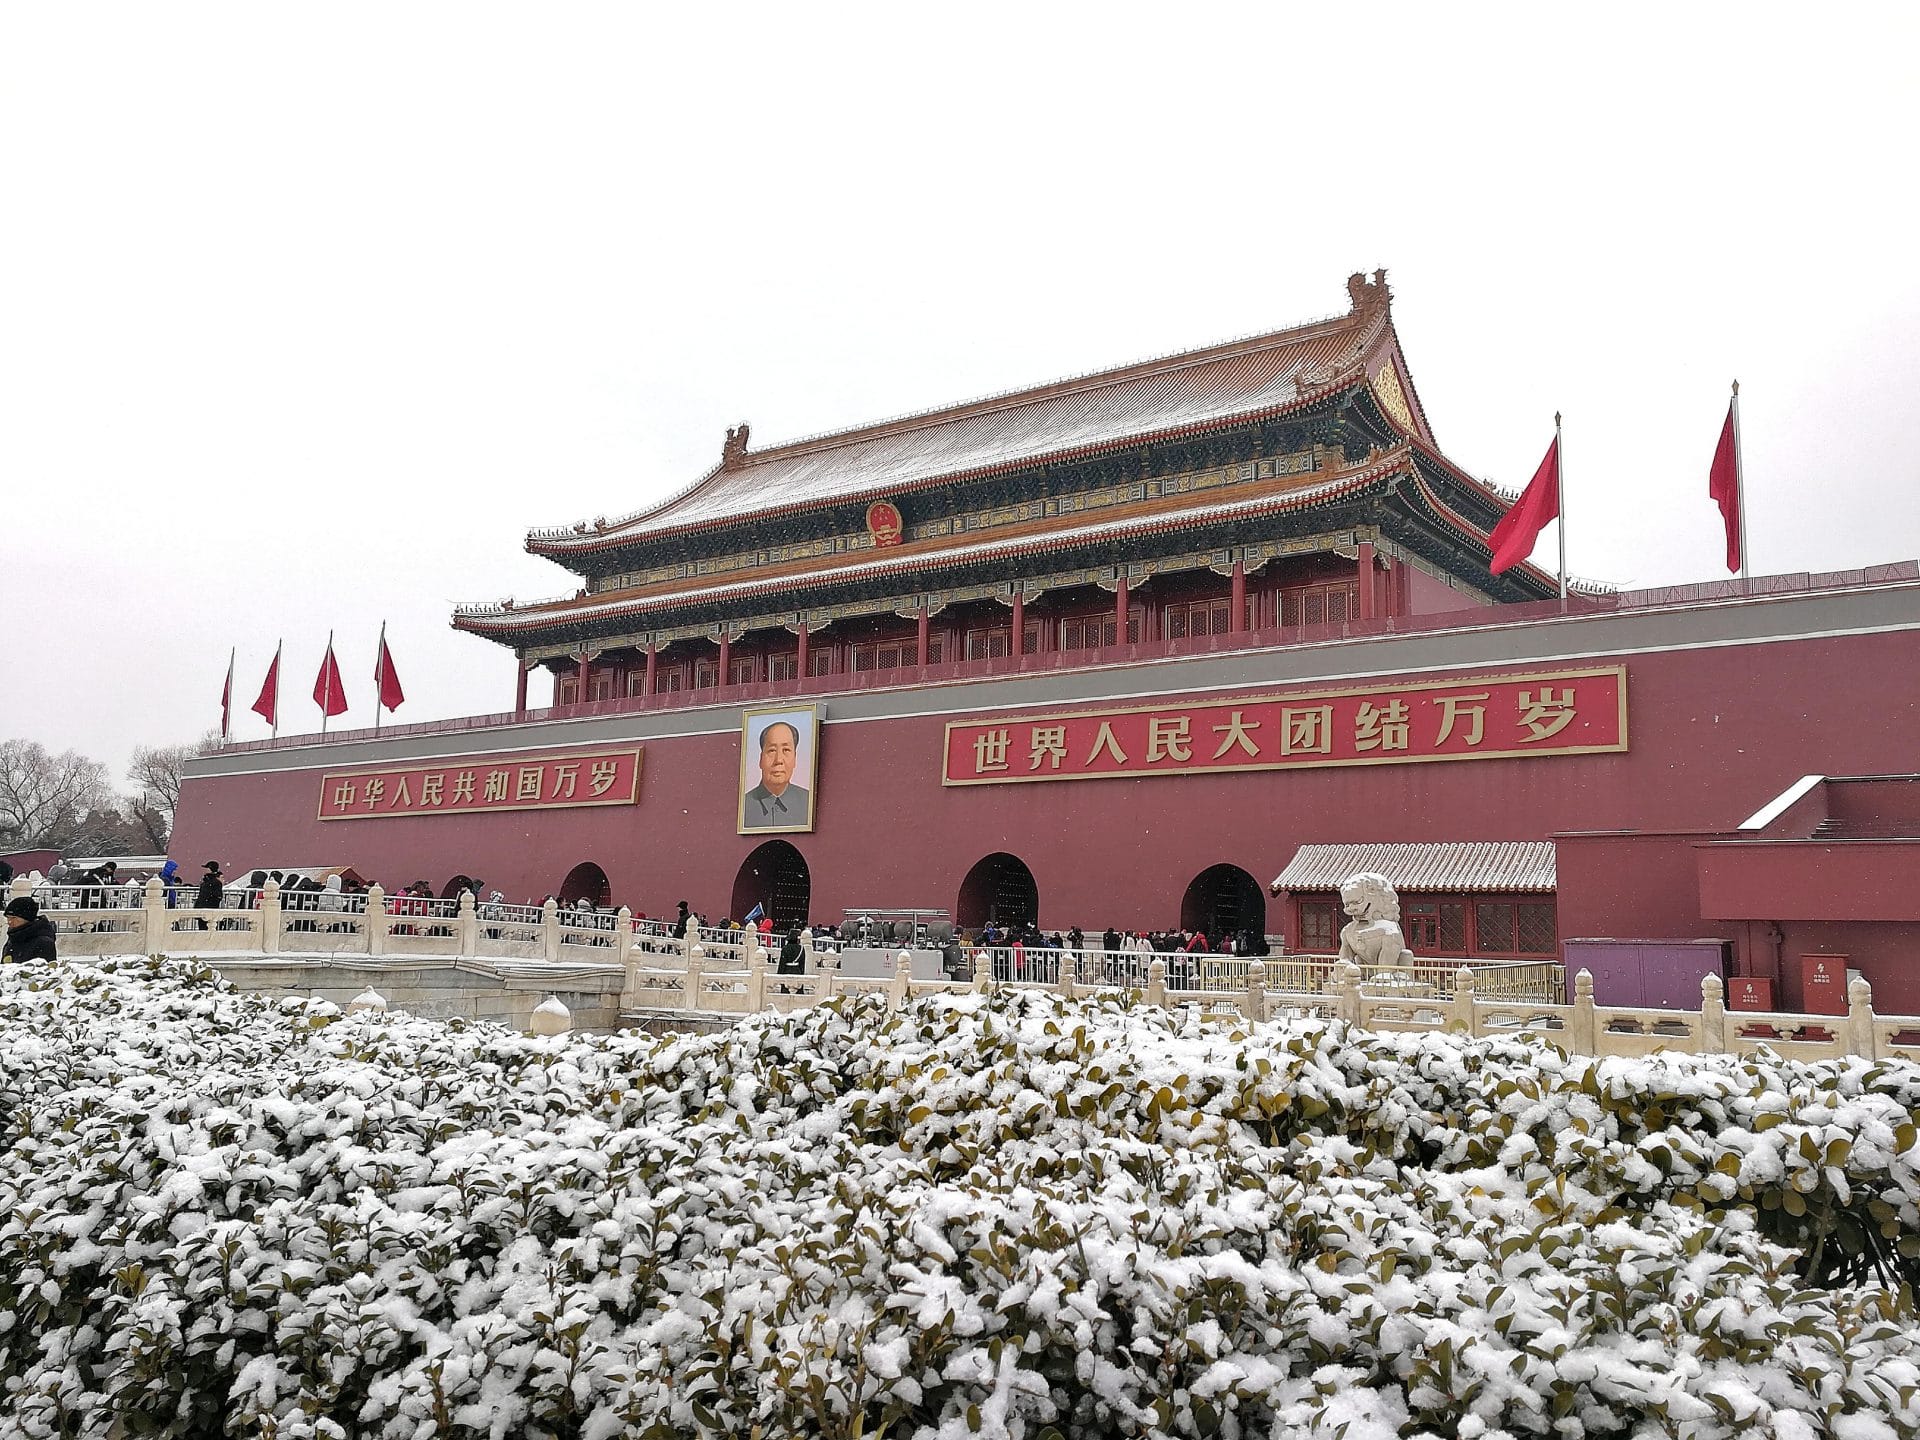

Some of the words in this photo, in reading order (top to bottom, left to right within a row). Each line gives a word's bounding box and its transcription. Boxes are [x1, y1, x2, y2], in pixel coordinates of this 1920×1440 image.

[973, 687, 1577, 773] 世界人民大团结万岁
[333, 760, 618, 811] 中华人民共和国万岁
